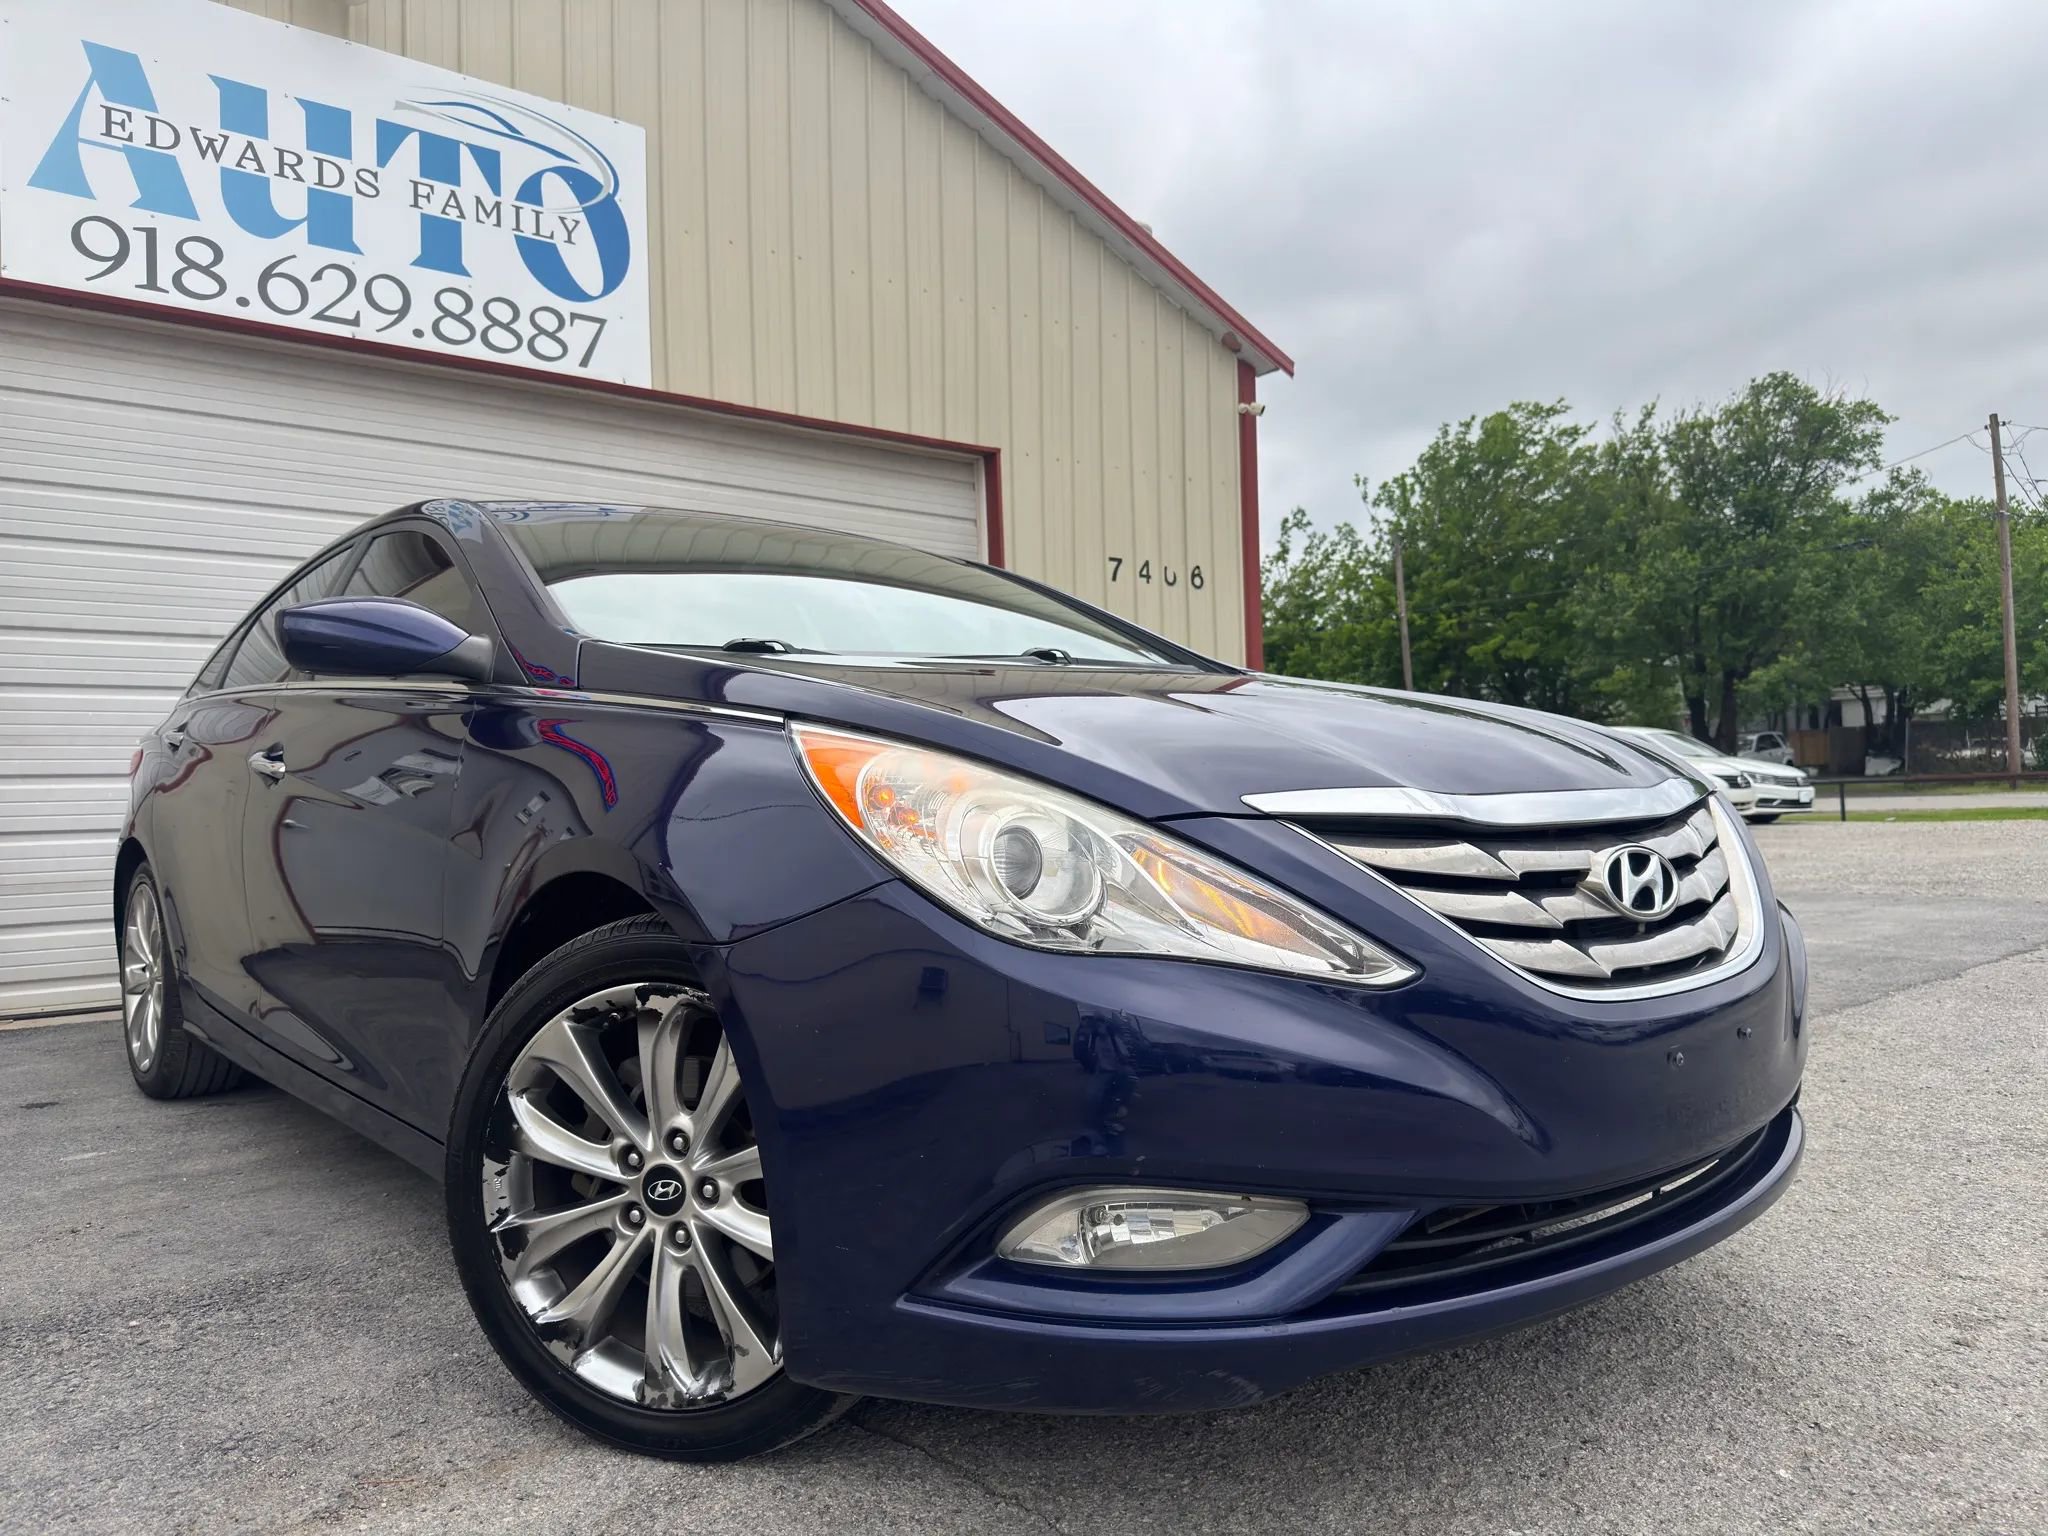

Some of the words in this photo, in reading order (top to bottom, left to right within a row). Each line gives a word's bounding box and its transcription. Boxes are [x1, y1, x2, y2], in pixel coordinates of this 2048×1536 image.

[100, 104, 381, 199] EDWARDS
[409, 179, 581, 245] FAMILY
[70, 215, 608, 368] 918.629.8887
